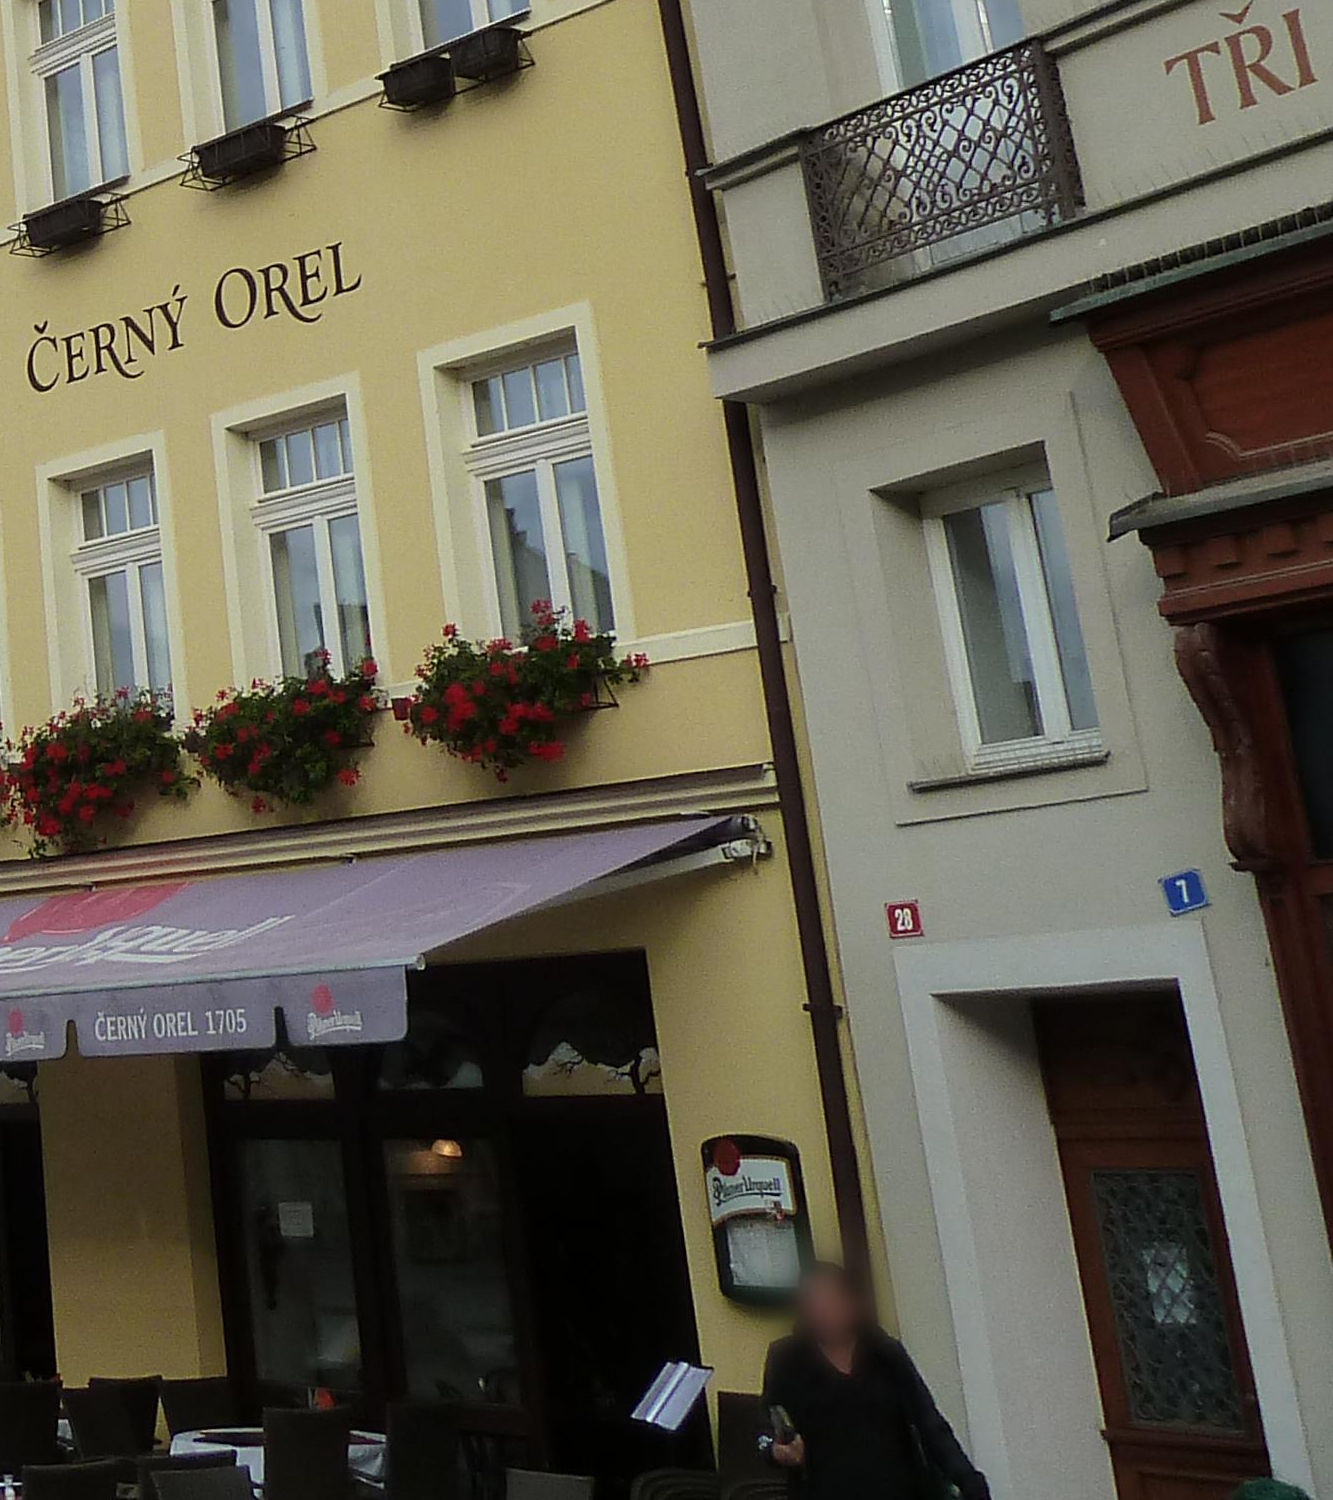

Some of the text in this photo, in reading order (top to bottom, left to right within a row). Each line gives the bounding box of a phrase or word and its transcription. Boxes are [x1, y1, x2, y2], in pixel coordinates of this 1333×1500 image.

[26, 241, 362, 393] ČERNÝ OREL
[894, 907, 913, 931] 28
[95, 1007, 247, 1041] ČERNÝ OREL 1705
